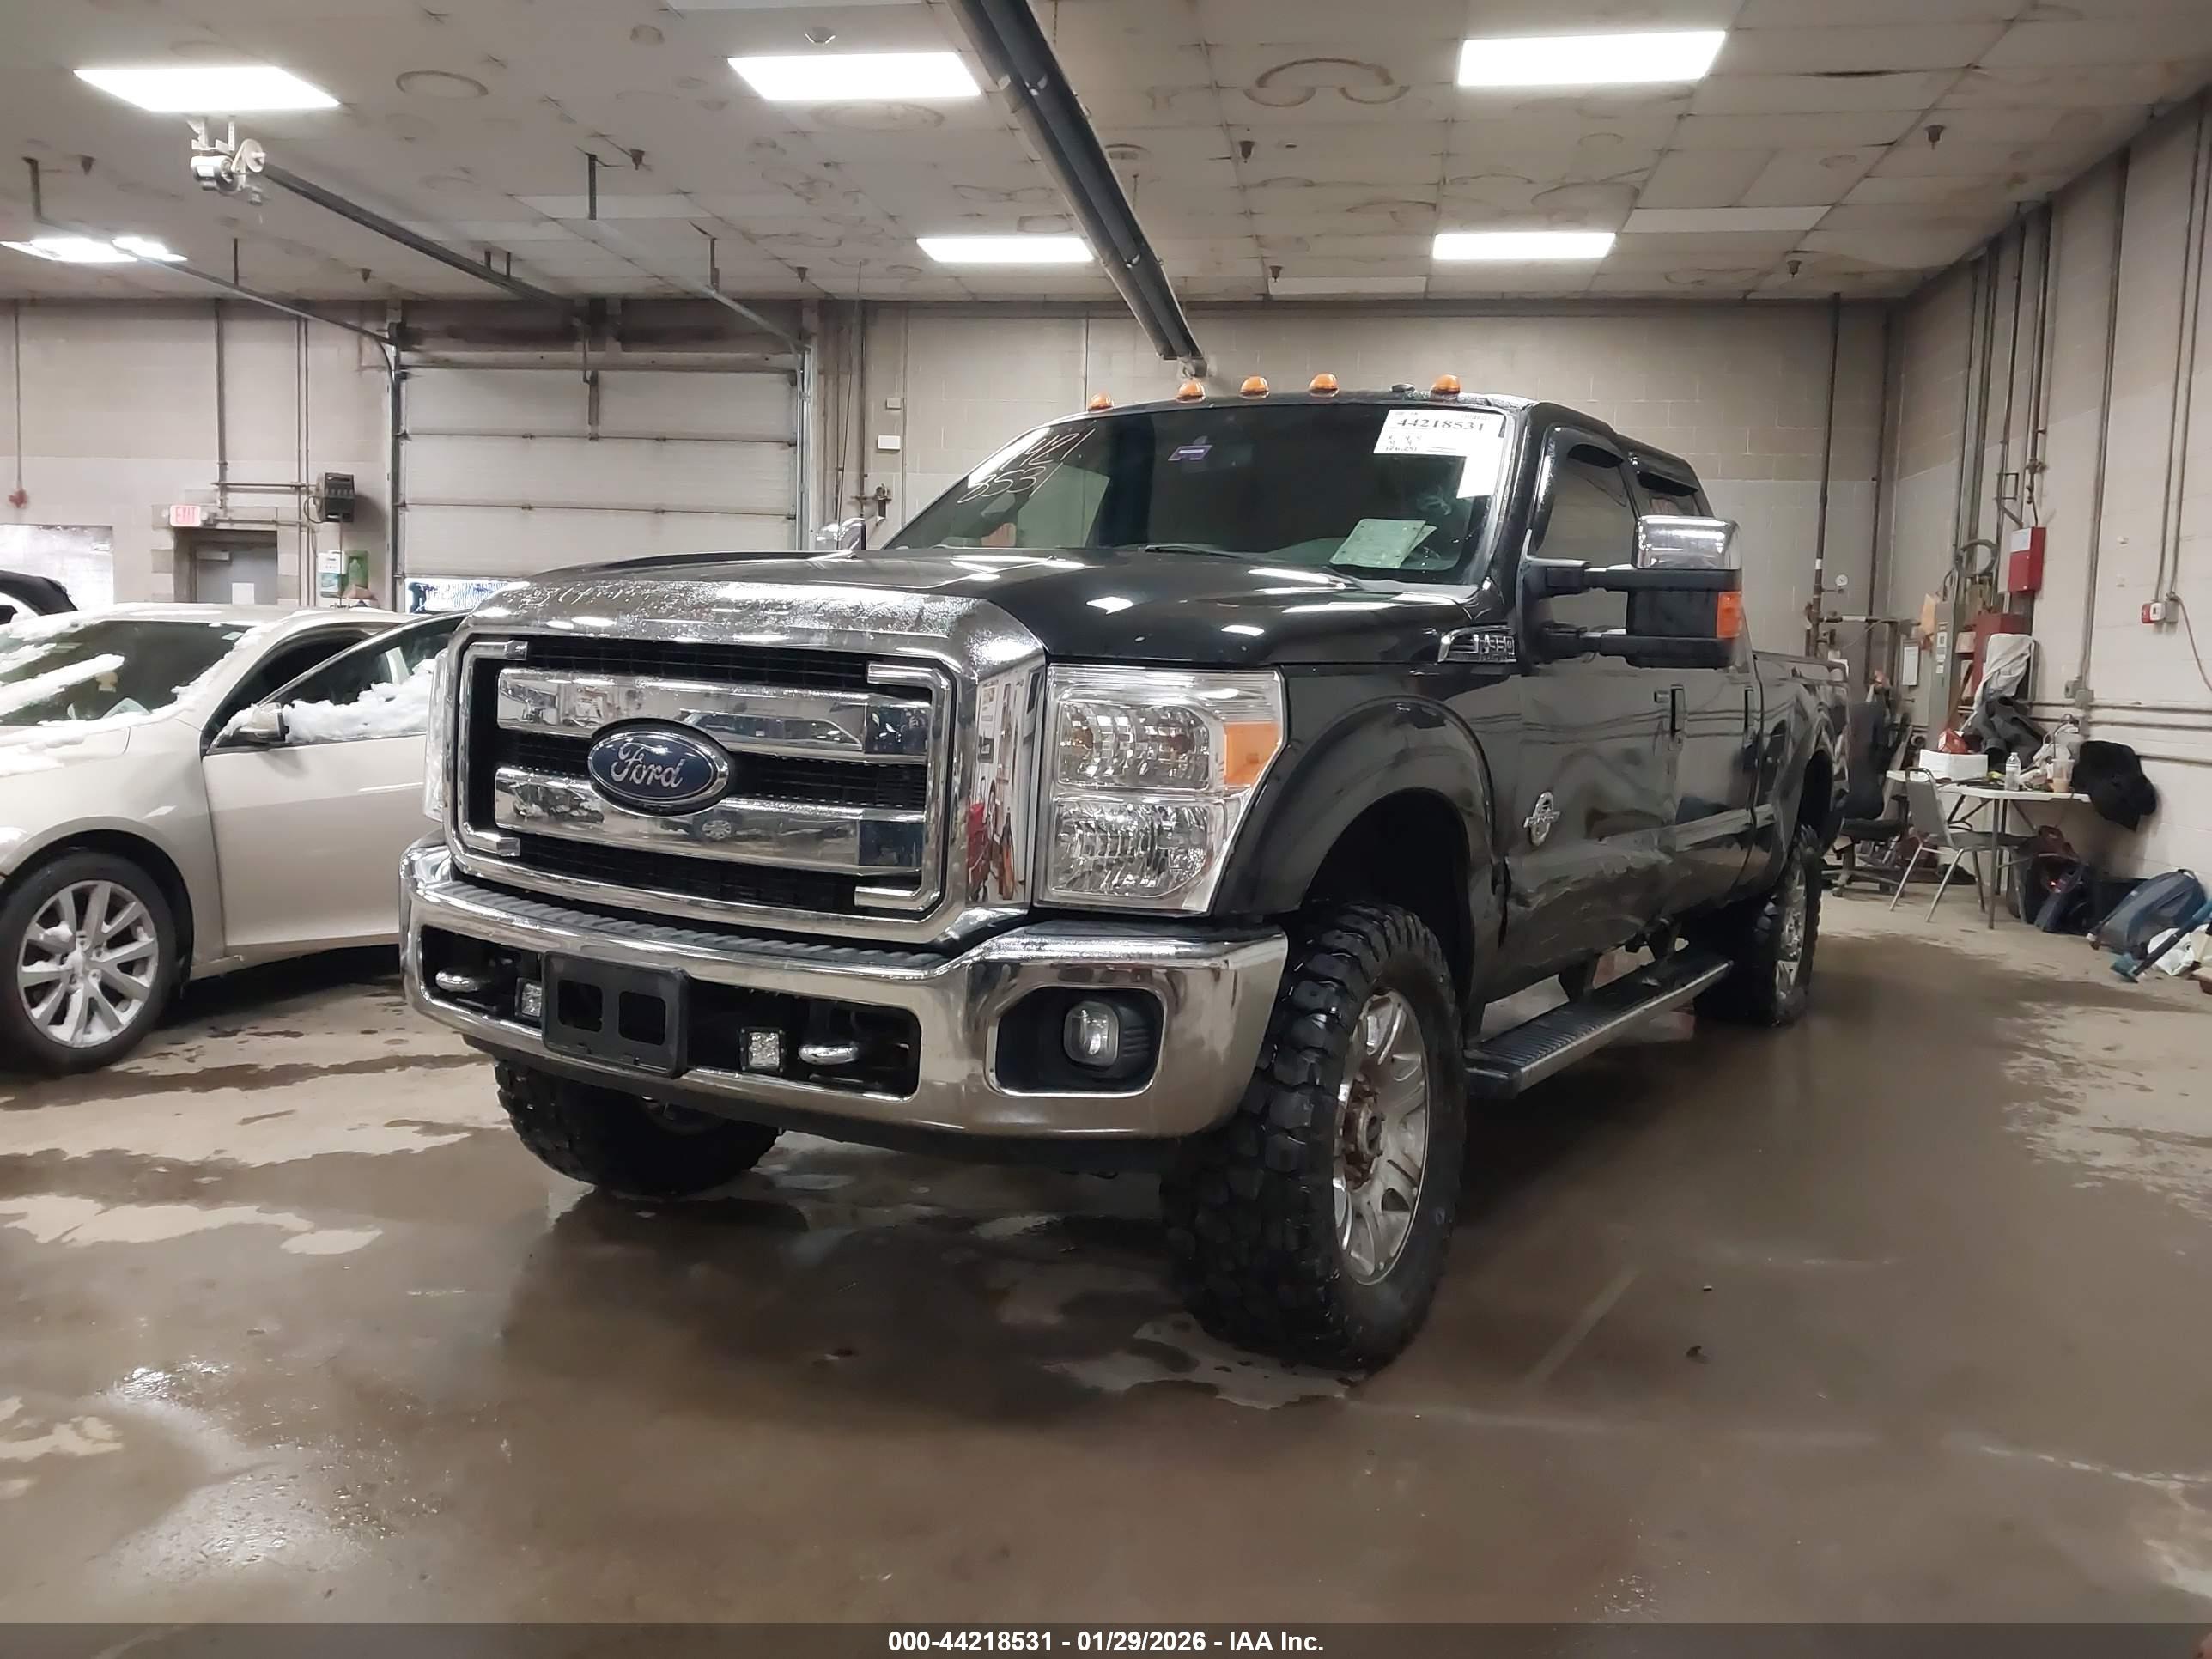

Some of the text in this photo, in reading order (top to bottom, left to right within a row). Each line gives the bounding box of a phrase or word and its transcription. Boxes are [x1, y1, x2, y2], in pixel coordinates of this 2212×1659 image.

[1397, 418, 1484, 431] 44218531
[175, 507, 197, 523] EXIT
[611, 742, 686, 788] Ford
